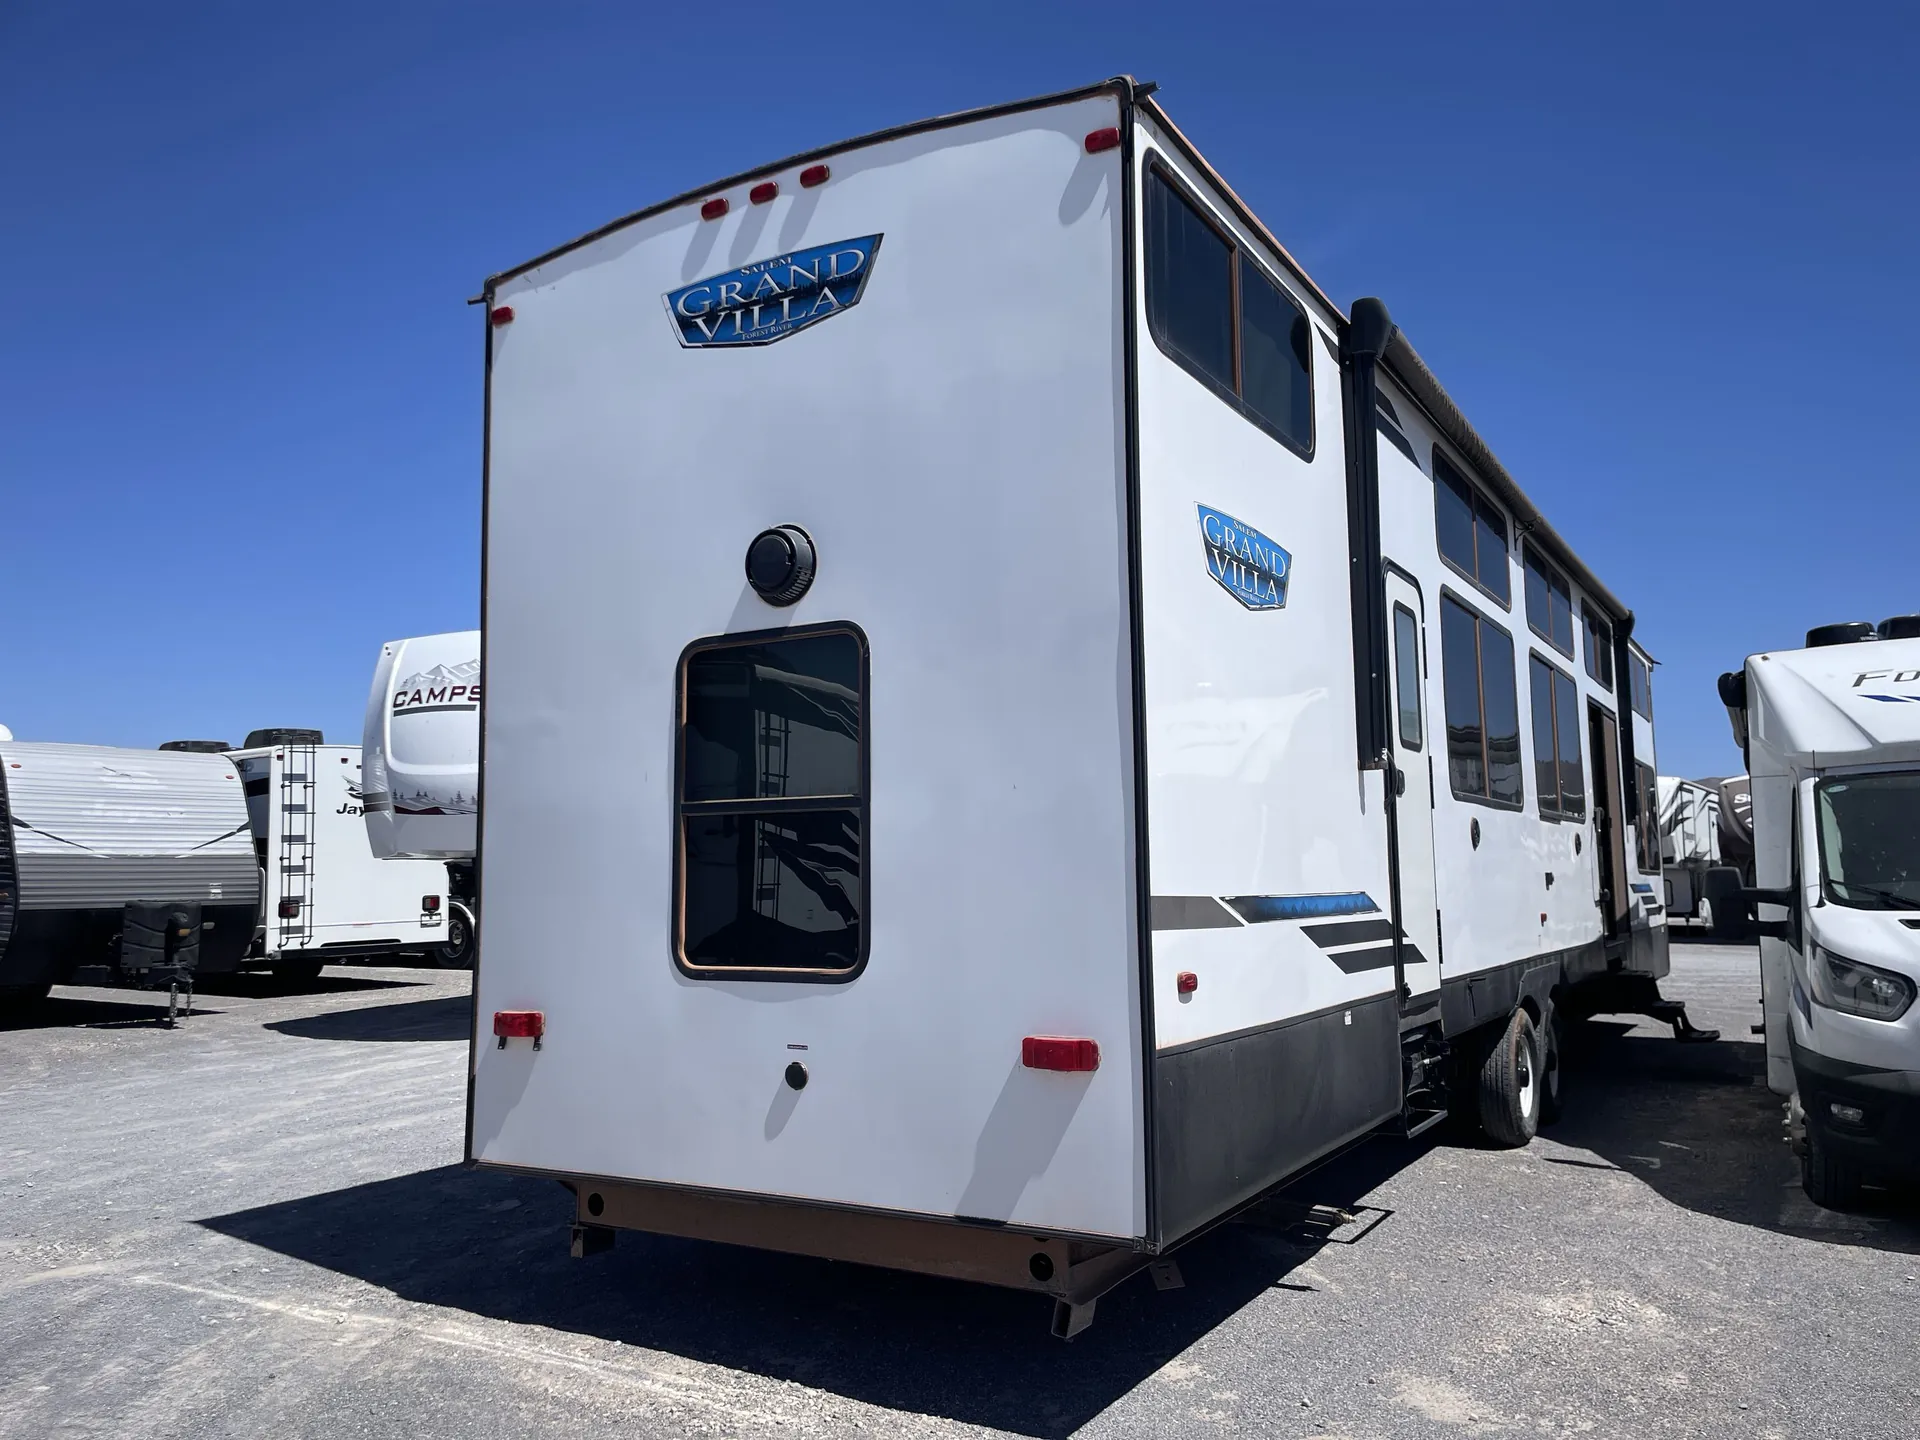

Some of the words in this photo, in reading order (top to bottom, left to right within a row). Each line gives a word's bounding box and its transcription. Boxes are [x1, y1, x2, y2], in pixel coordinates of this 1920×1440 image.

[677, 248, 865, 317] GRAND
[692, 286, 842, 341] VILLA
[1203, 514, 1287, 578] GRAND
[1211, 547, 1280, 605] VILLA
